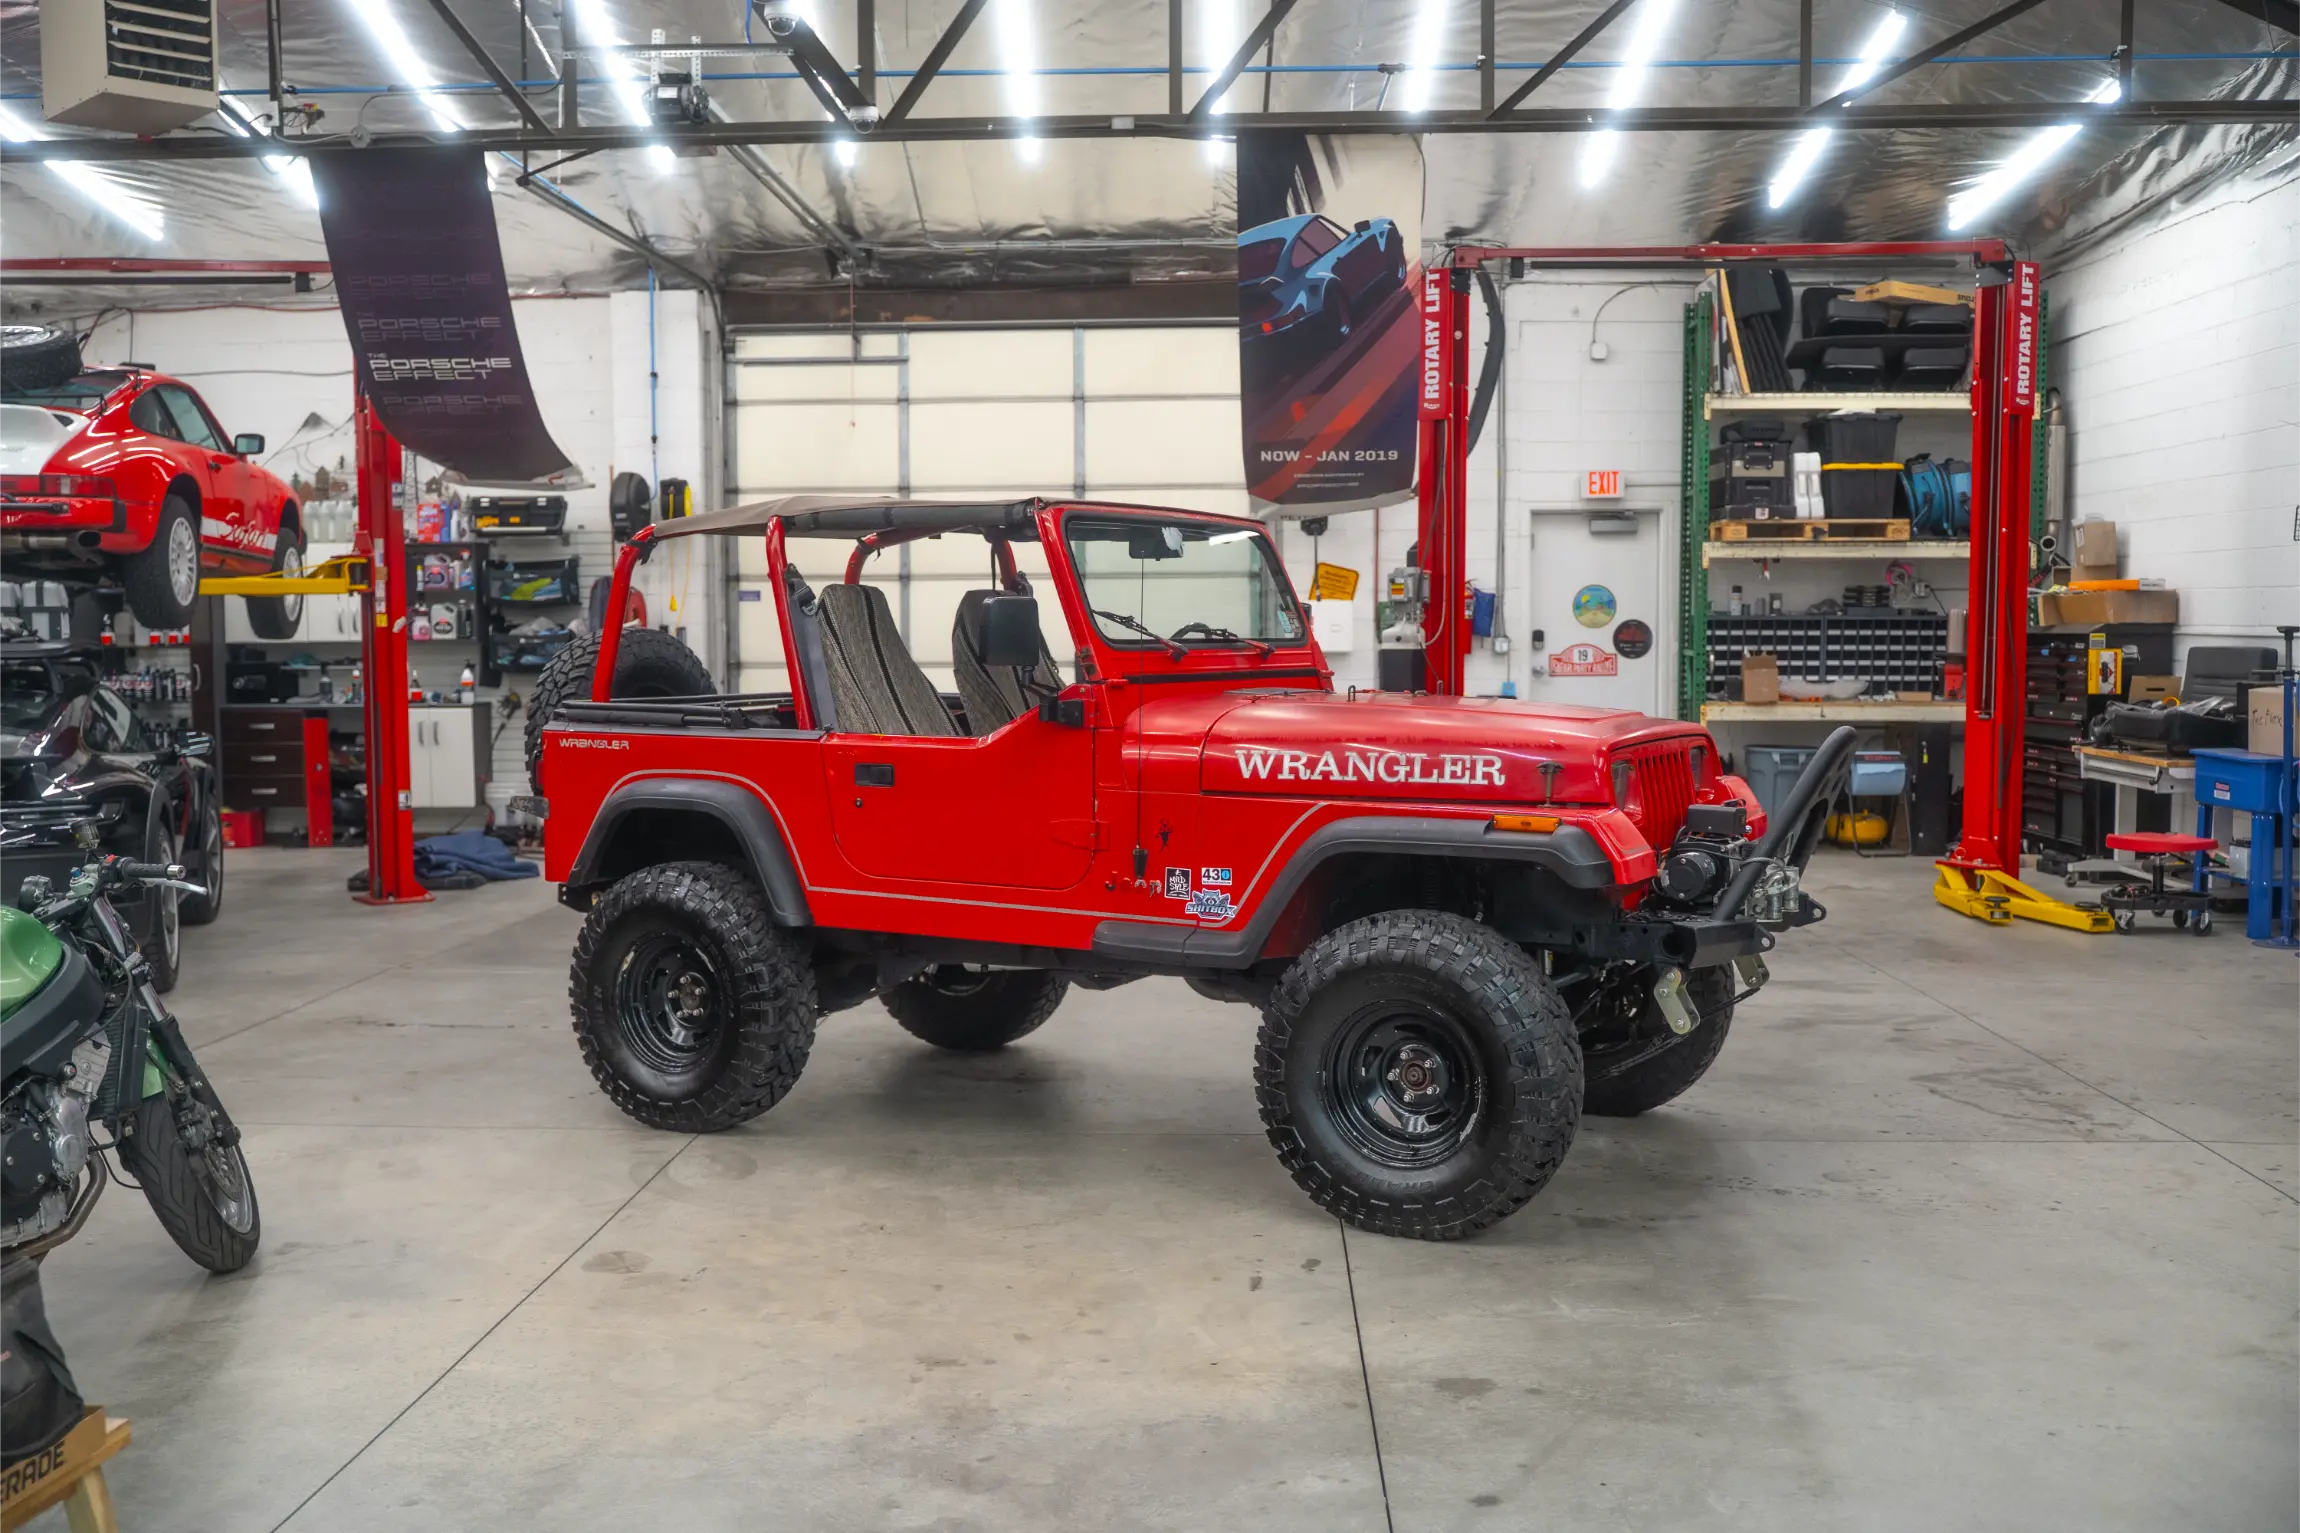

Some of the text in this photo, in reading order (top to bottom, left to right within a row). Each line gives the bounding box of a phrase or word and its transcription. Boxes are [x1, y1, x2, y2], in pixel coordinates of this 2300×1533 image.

[1425, 269, 1441, 313] LIFT
[2020, 264, 2034, 307] LIFT
[357, 317, 501, 330] PORSCHE
[360, 330, 480, 343] EFFECT
[1424, 319, 1441, 399] ROTARY
[2016, 312, 2033, 395] ROTARY
[368, 357, 513, 370] PORSCHE
[372, 369, 492, 382] EFFECT
[1260, 450, 1300, 462] NOW
[1317, 450, 1350, 462] JAN
[1354, 450, 1399, 462] 2019
[1588, 471, 1619, 495] EXIT
[1577, 649, 1588, 662] 19
[558, 737, 630, 751] WRANGLER
[1235, 749, 1506, 786] WRANGLER
[1186, 903, 1235, 917] SHITBOX
